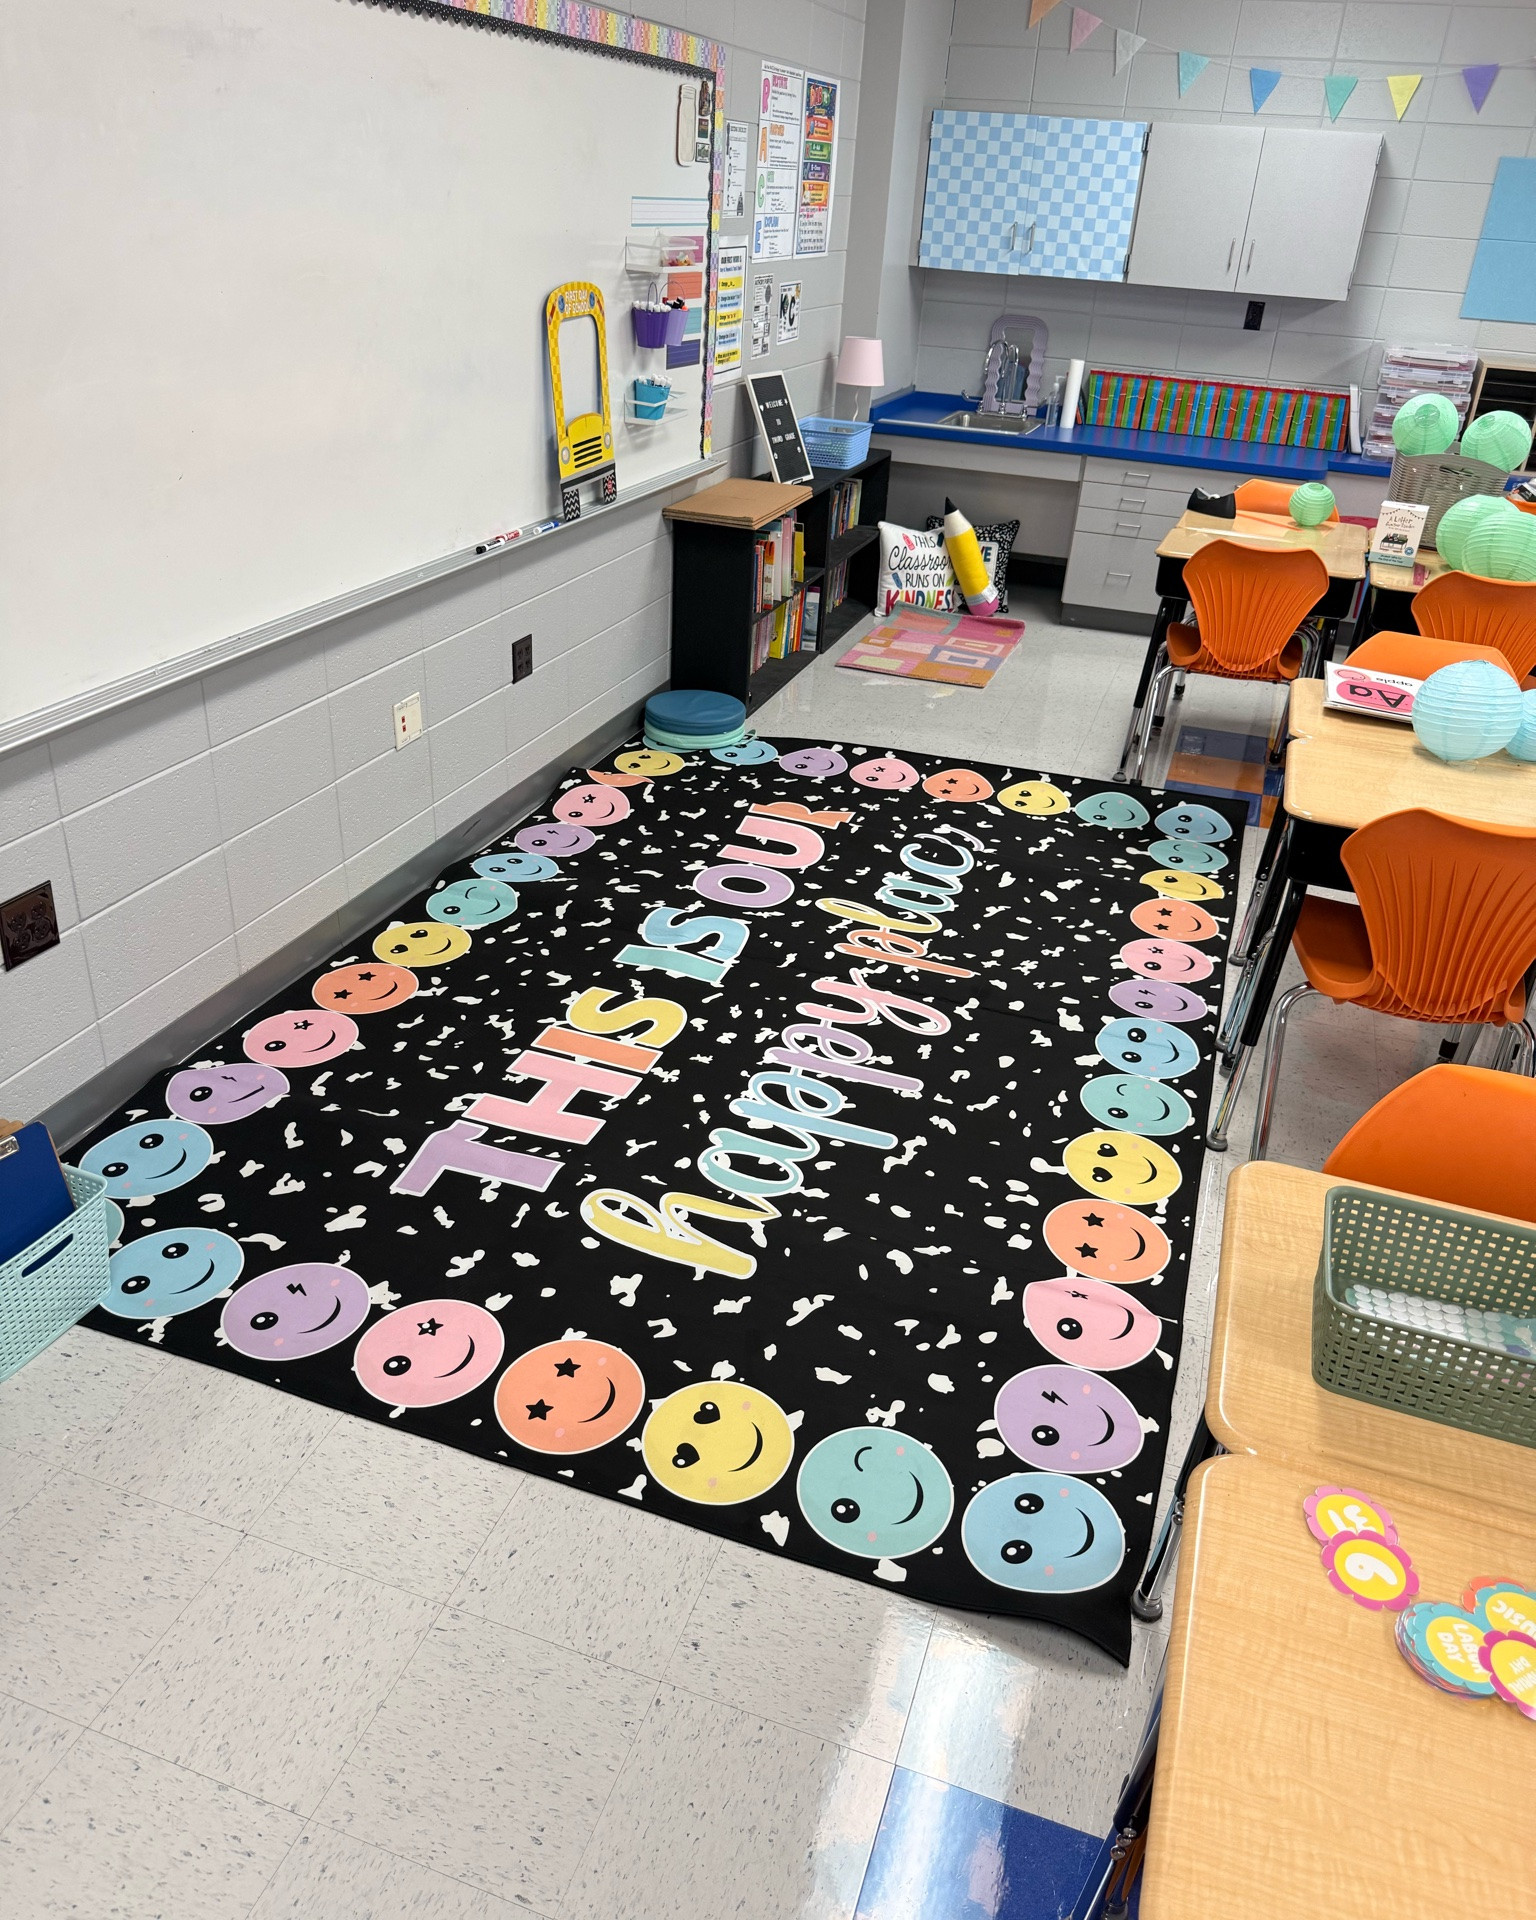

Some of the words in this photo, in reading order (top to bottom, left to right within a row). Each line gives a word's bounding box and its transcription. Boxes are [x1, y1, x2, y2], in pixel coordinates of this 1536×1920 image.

[759, 126, 768, 164] A
[757, 173, 765, 208] C
[754, 220, 762, 254] E
[565, 290, 578, 303] FIRST
[579, 289, 588, 301] DAY
[565, 303, 571, 314] OF
[572, 301, 591, 313] SCHOOL
[765, 399, 784, 409] WELCOME
[784, 432, 796, 440] GRADE
[912, 534, 937, 549] THIS
[905, 572, 930, 588] RUNS
[932, 573, 945, 588] ON
[1375, 677, 1413, 687] apple
[1348, 684, 1407, 708] Aa
[389, 986, 688, 1197] THIS
[612, 906, 751, 983] IS
[693, 801, 857, 909] OUR
[580, 967, 952, 1280] happy
[1491, 1600, 1536, 1641] USIC
[1437, 1632, 1465, 1664] DAY
[1508, 1655, 1532, 1675] DAY
